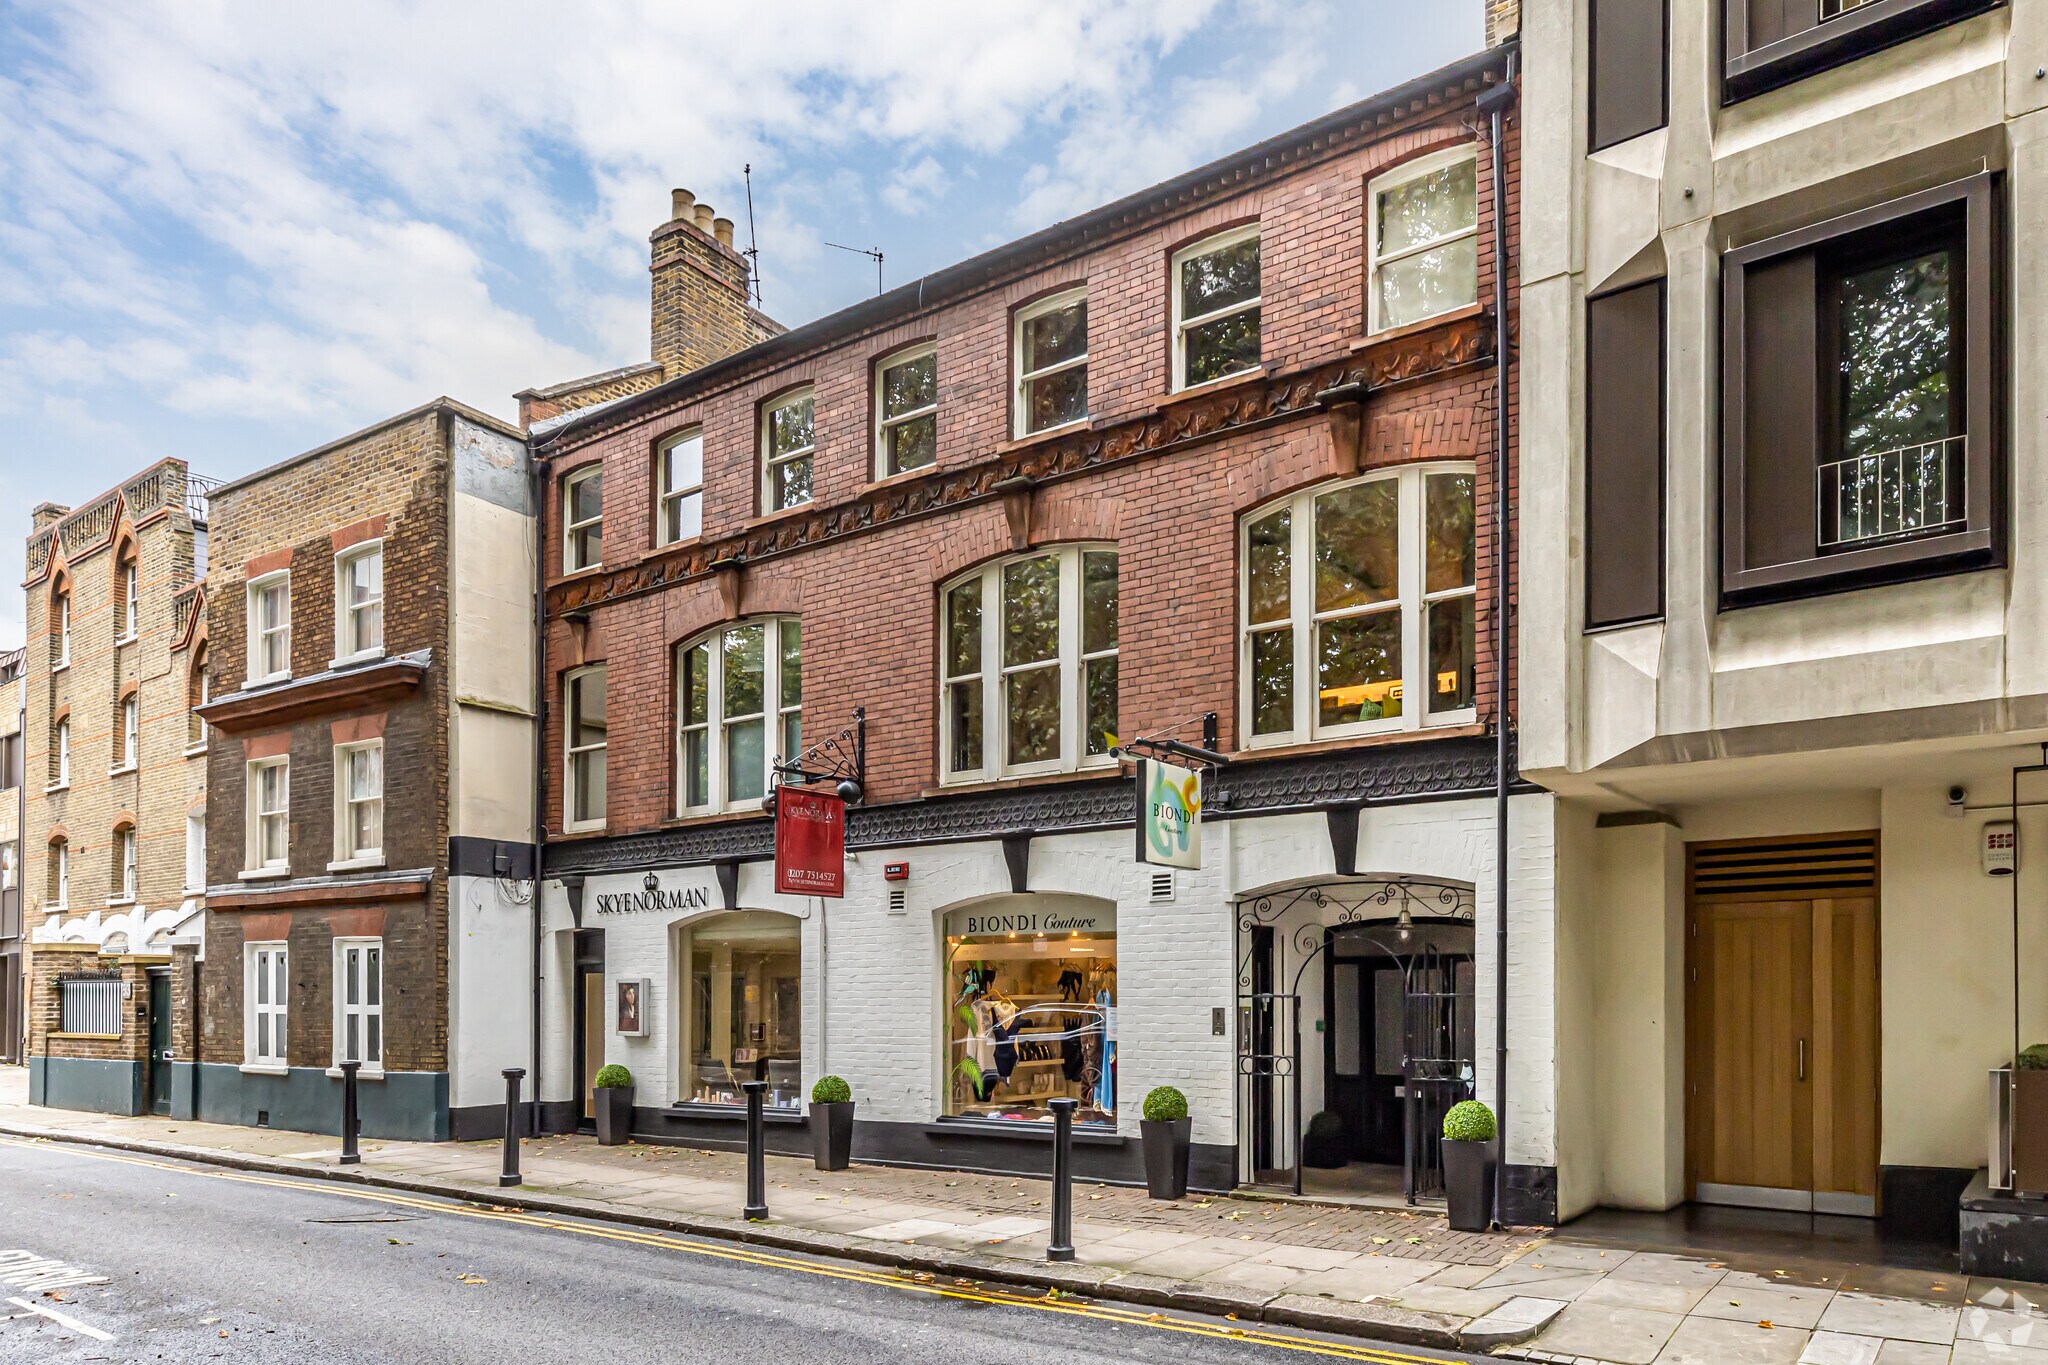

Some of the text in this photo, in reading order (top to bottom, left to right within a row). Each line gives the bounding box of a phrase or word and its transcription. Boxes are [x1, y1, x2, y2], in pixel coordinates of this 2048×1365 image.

[1153, 803, 1194, 825] BIONDI
[787, 869, 836, 881] 0207 7514527
[596, 886, 708, 914] SKYENORMAN
[968, 913, 1096, 933] BIONDI Couture
